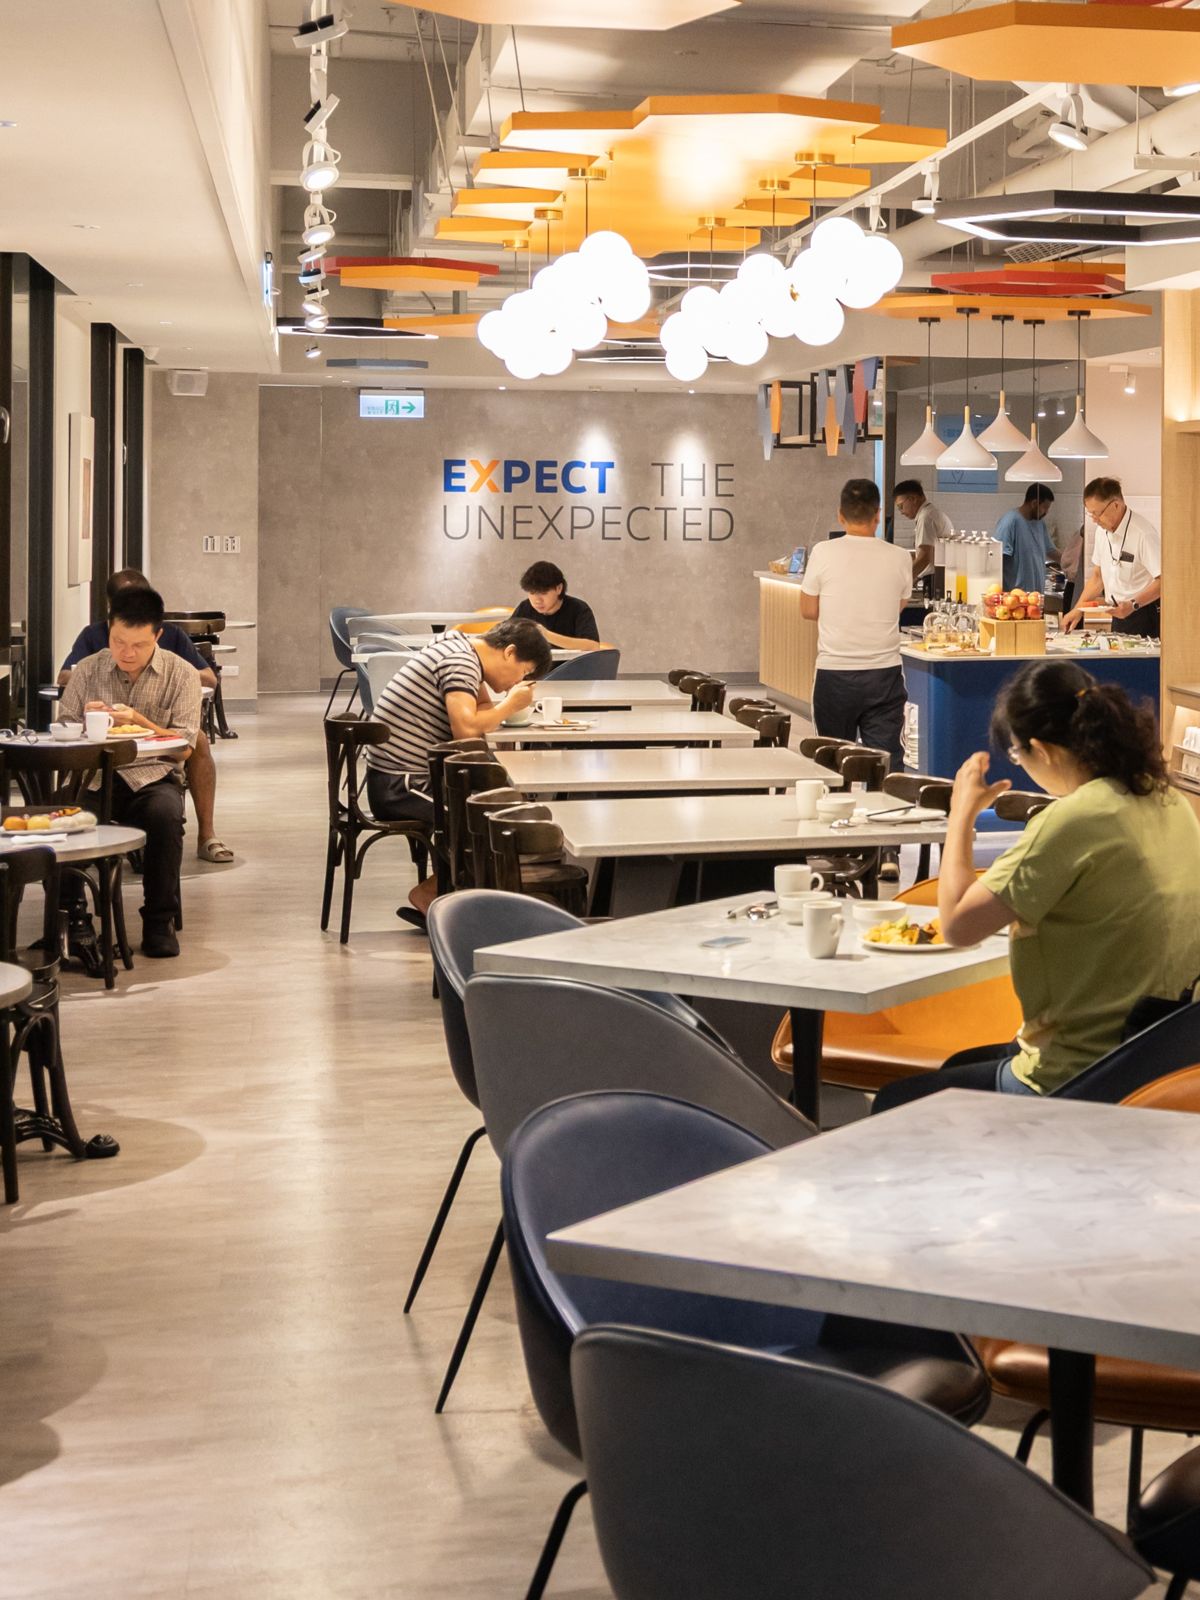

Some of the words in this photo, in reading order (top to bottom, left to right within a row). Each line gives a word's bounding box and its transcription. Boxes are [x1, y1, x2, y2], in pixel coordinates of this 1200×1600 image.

[443, 459, 615, 494] EXPECT
[651, 462, 735, 497] THE
[443, 504, 735, 542] UNEXPECTED
